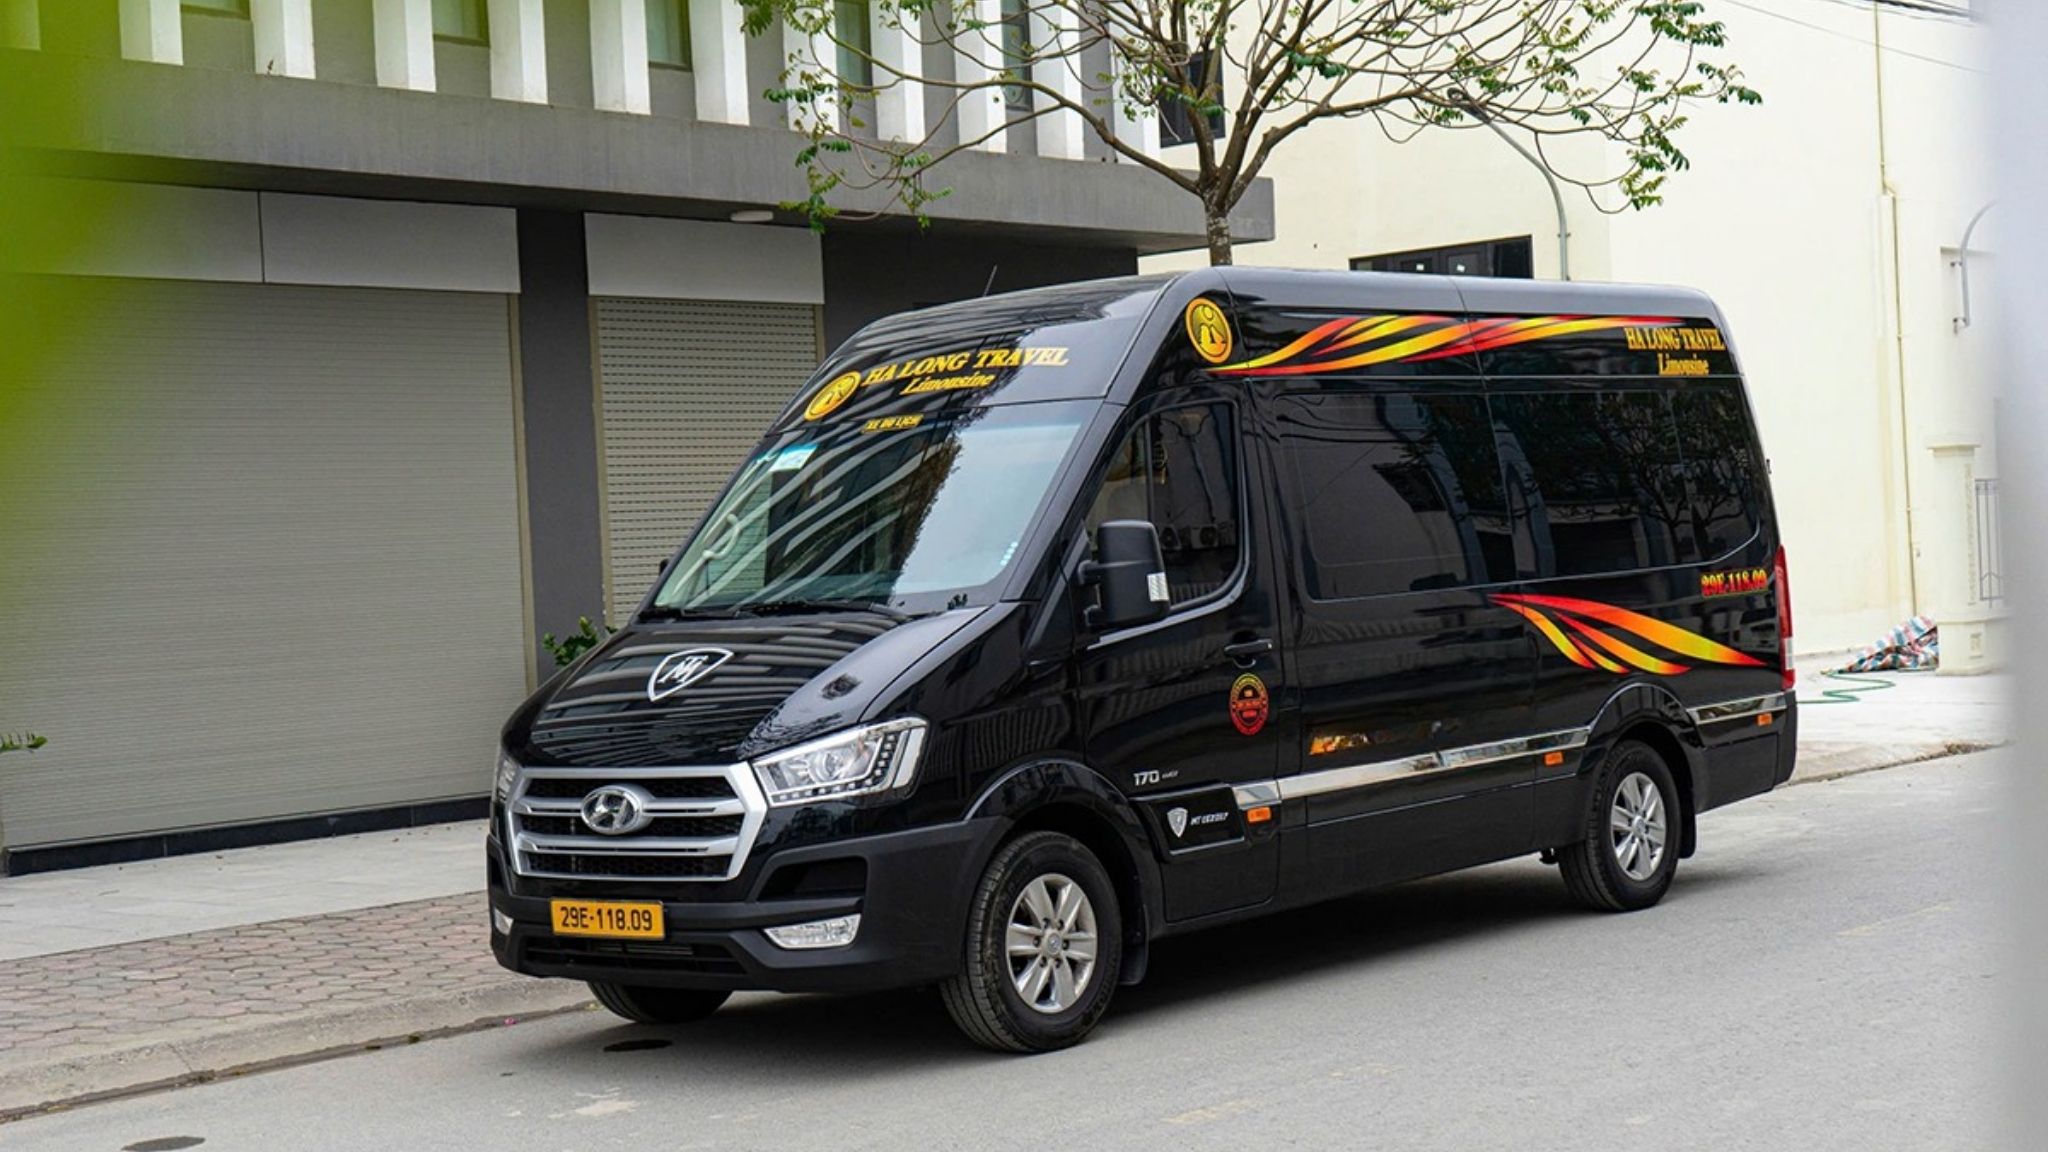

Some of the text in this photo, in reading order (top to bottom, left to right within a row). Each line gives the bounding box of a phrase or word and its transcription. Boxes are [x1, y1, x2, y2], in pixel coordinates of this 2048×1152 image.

[1645, 327, 1681, 350] LONG
[1679, 327, 1726, 350] TRAVEL
[862, 347, 1070, 387] HA LONG TRAVEL
[1656, 353, 1710, 376] Limousine
[899, 370, 997, 396] Limousine
[1133, 769, 1160, 787] 170
[559, 905, 653, 932] 29E-118.09
